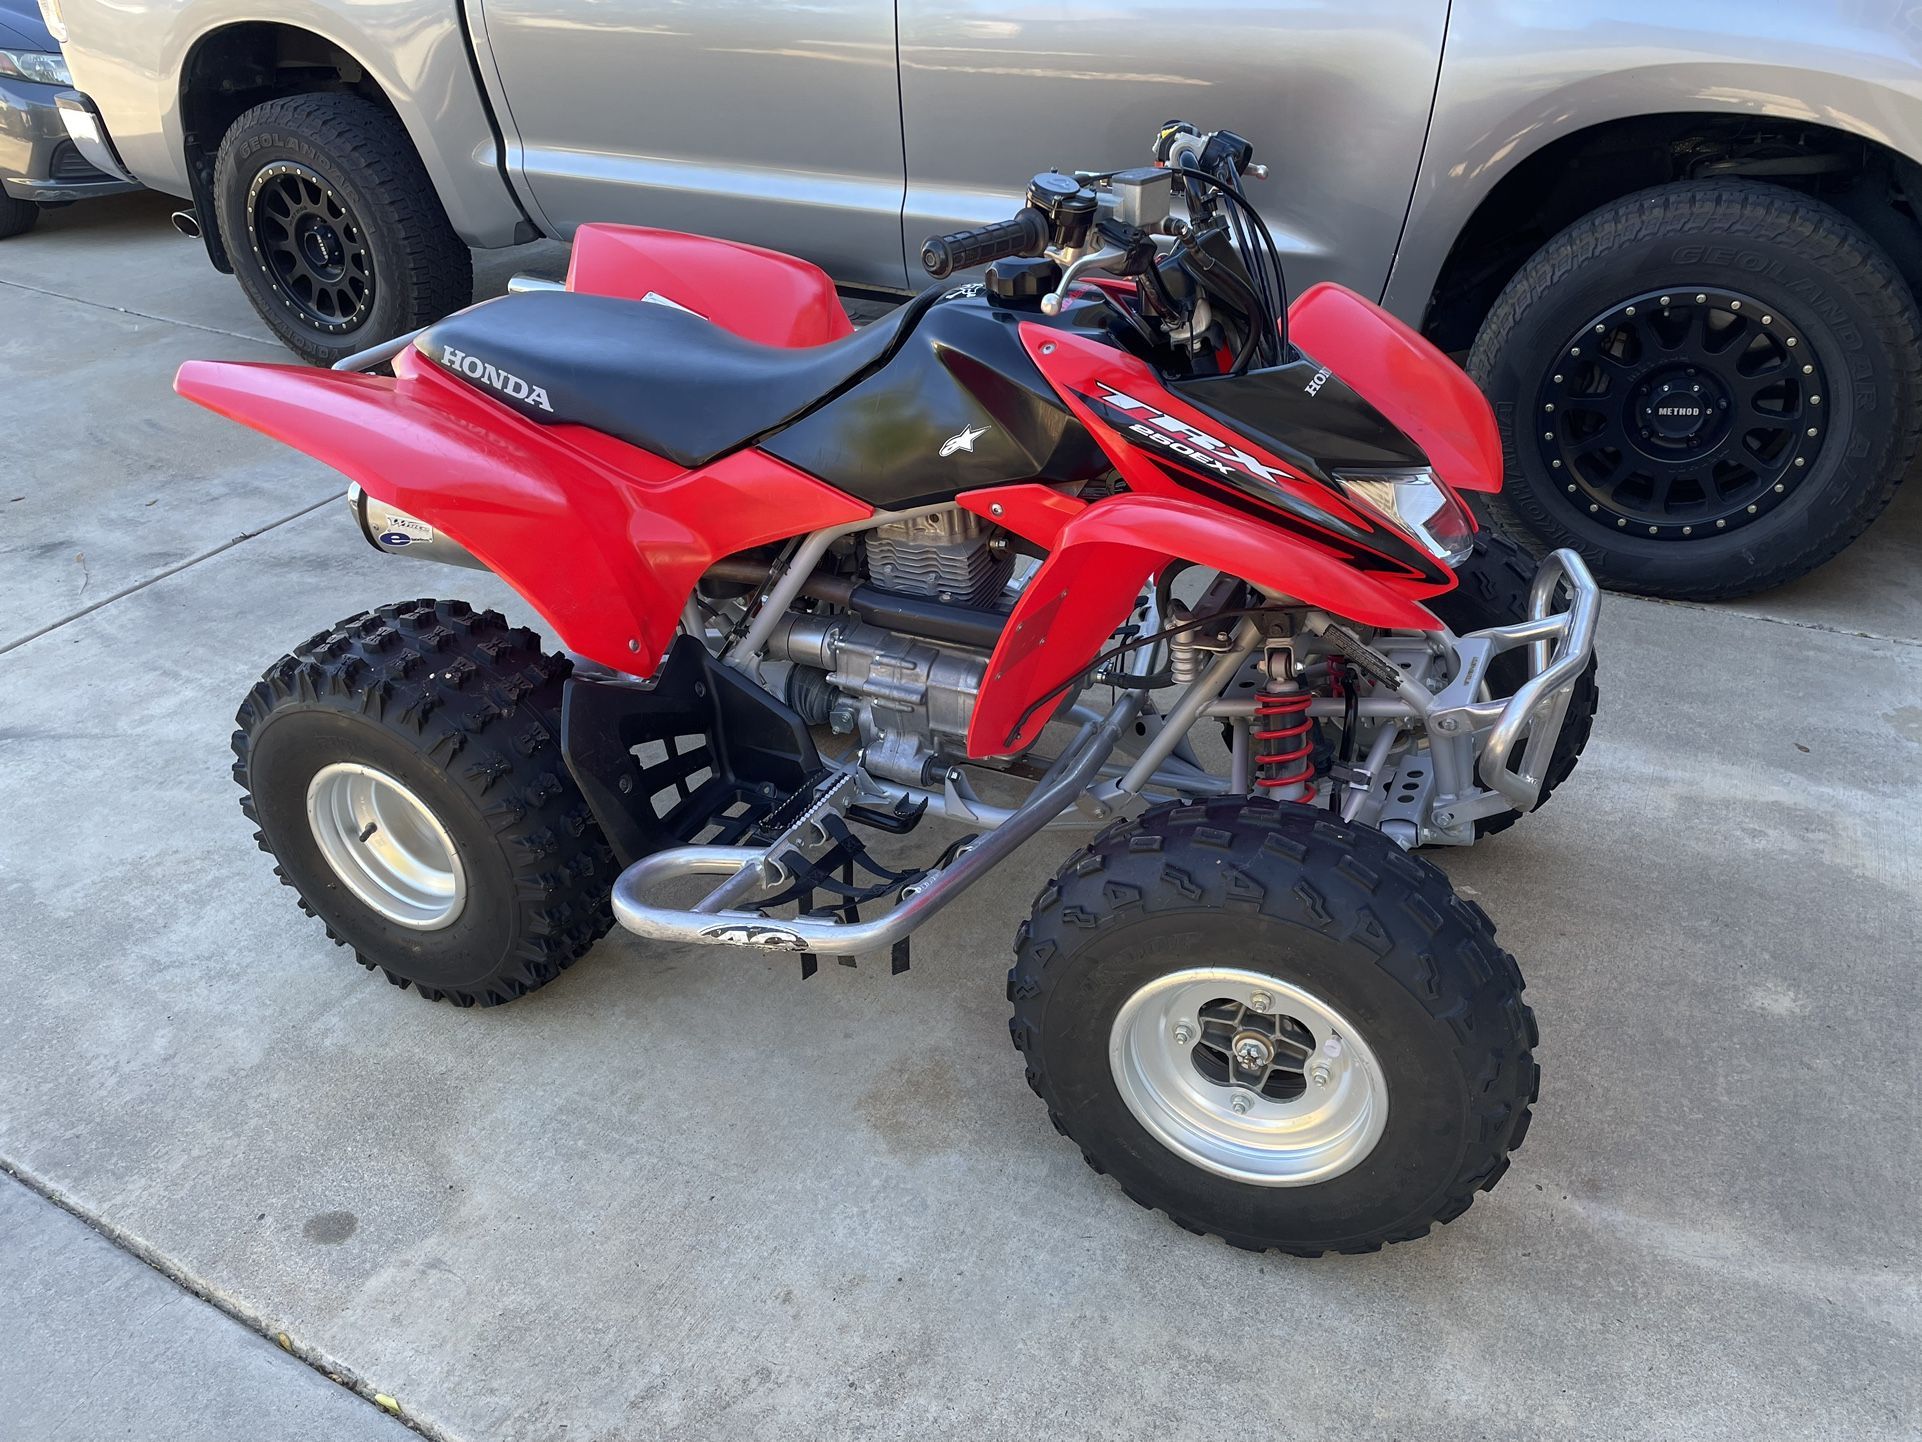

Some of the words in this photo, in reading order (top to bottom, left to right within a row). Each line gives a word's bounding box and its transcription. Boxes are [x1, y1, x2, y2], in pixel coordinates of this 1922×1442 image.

[1671, 244, 1877, 411] GEOLANDAR
[441, 345, 554, 413] HONDA
[1658, 407, 1700, 416] METHOD
[1096, 381, 1296, 484] TRX
[1128, 423, 1236, 475] 250EX
